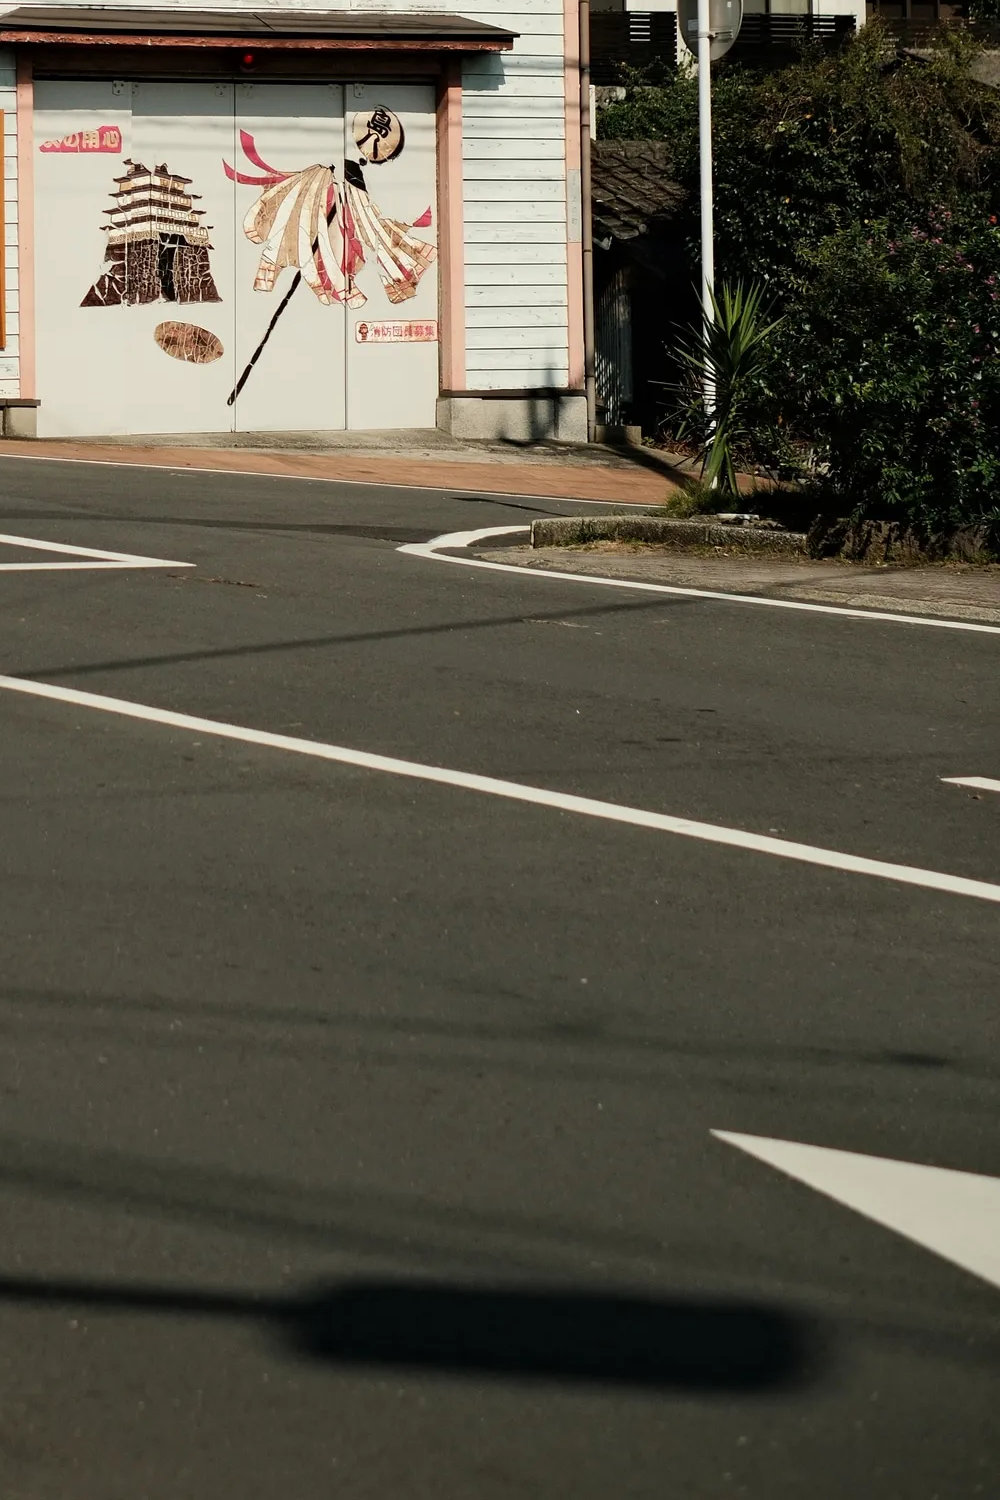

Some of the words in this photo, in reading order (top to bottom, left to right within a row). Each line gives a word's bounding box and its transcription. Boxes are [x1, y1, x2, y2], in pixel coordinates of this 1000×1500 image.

[370, 324, 435, 337] 消防団員募集
